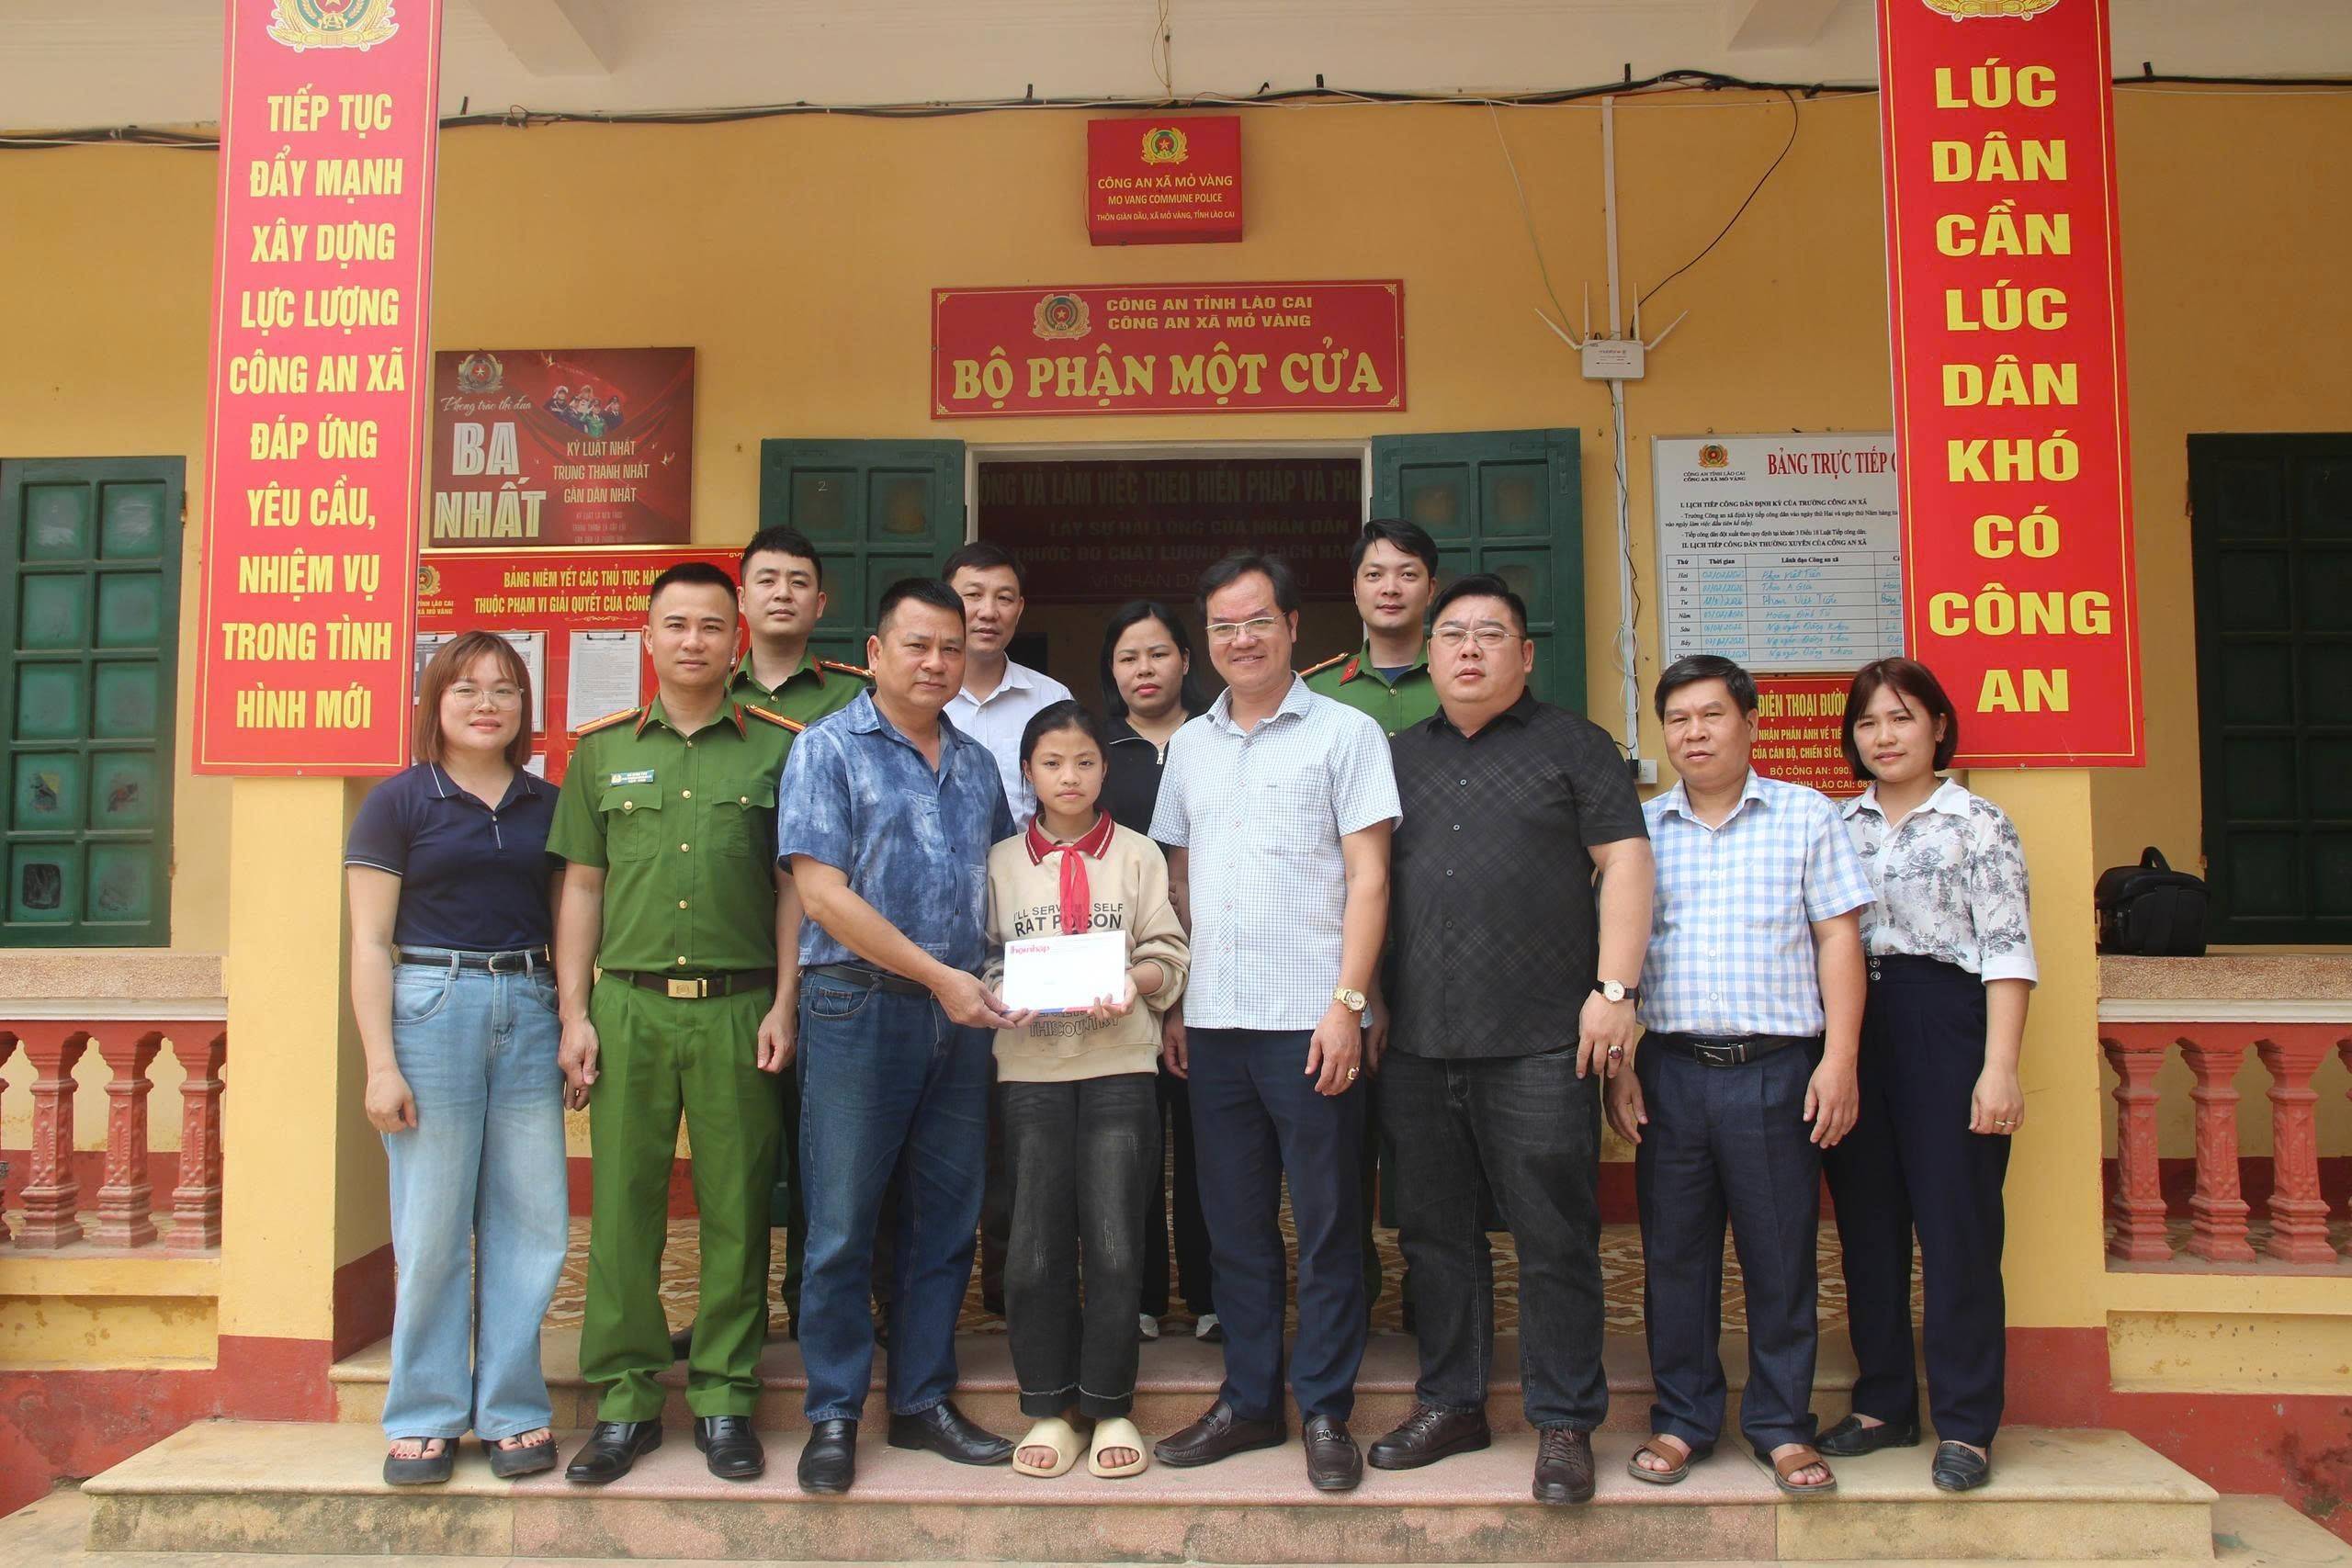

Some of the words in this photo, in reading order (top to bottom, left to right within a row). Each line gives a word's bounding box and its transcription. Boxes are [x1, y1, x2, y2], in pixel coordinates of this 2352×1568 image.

[1935, 57, 2057, 108] LÚC
[267, 84, 330, 132] TIẾP
[338, 94, 393, 139] TỤC
[250, 144, 308, 198] ĐẨY
[315, 158, 402, 204] MẠNH
[1931, 130, 2067, 183] DÂN
[1098, 176, 1132, 189] CÔNG
[1135, 177, 1152, 188] AN
[1155, 175, 1171, 187] XÃ
[1175, 173, 1196, 187] MỎ
[1199, 174, 1233, 186] VÀNG
[1108, 196, 1123, 205] MO
[1125, 195, 1148, 205] VANG
[1148, 194, 1193, 204] COMMUNE
[1194, 193, 1223, 203] POLICE
[1097, 212, 1115, 221] THÔN
[1210, 209, 1223, 219] LÀO
[1935, 198, 2071, 257] CẦN
[250, 218, 309, 263] XÂY
[316, 220, 395, 269] DỰNG
[241, 287, 295, 336] LỰC
[304, 286, 399, 334] LƯỢNG
[1106, 295, 1158, 310] CÔNG
[1161, 297, 1190, 310] AN
[1193, 293, 1237, 310] TỈNH
[1241, 293, 1278, 310] LÀO
[1282, 296, 1313, 309] CAI
[1108, 312, 1159, 330] CÔNG
[1163, 316, 1192, 330] AN
[1195, 313, 1222, 329] XÃ
[1226, 311, 1256, 329] MỎ
[1261, 311, 1312, 328] VÀNG
[1946, 279, 2068, 332] LÚC
[230, 348, 309, 394] CÔNG
[316, 355, 358, 393] AN
[367, 347, 405, 392] XÃ
[952, 344, 1014, 410] BỘ
[1026, 343, 1157, 407] PHẬN
[1169, 341, 1268, 406] MỘT
[1280, 335, 1384, 394] CỬA
[1942, 354, 2078, 406] DÂN
[441, 396, 476, 417] Phong
[499, 396, 513, 412] thi
[250, 414, 310, 460] ĐÁP
[318, 412, 378, 459] ỨNG
[452, 422, 520, 476] BA
[582, 440, 607, 458] LUẬT
[609, 436, 637, 456] NHẤT
[1947, 429, 2080, 482] KHÓ
[553, 465, 585, 480] TRUNG
[588, 462, 620, 479] THÀNH
[623, 460, 650, 479] NHẤT
[1768, 447, 1808, 475] BẢNG
[1811, 449, 1851, 479] TRỰC
[1855, 446, 1887, 473] TIẾP
[246, 480, 301, 527] YÊU
[310, 475, 376, 531] CẦU,
[434, 477, 547, 539] NHẤT
[564, 485, 584, 503] GẦN
[587, 486, 607, 502] DÂN
[610, 483, 637, 502] NHẤT
[1052, 464, 1091, 505] LÀM
[1098, 463, 1139, 510] VIỆC
[1145, 470, 1191, 504] THEO
[1245, 462, 1295, 502] PHÁP
[1302, 463, 1327, 502] VÀ
[1827, 498, 1847, 506] CÔNG
[1973, 505, 2060, 559] CÓ
[238, 547, 334, 602] NHIỆM
[343, 555, 380, 602] VỤ
[503, 566, 530, 588] BẢNG
[532, 568, 558, 587] NIÊM
[560, 565, 577, 587] YẾT
[579, 566, 599, 587] CÁC
[601, 564, 619, 587] THỦ
[622, 570, 640, 590] TỤC
[475, 594, 505, 617] THUỘC
[507, 596, 536, 616] PHẠM
[537, 596, 547, 613] VI
[549, 590, 568, 613] GIẢI
[571, 591, 602, 614] QUYẾT
[604, 589, 623, 612] CỦA
[1929, 582, 2111, 636] CÔNG
[221, 622, 316, 661] TRONG
[326, 615, 392, 660] TÌNH
[236, 682, 306, 728] HÌNH
[315, 682, 371, 728] MỚI
[1758, 690, 1783, 722] ĐIỆN
[1785, 694, 1816, 722] THOẠI
[1976, 669, 2069, 713] AN
[1752, 744, 1767, 760] CỦA
[1769, 746, 1784, 759] CÁN
[1786, 745, 1799, 762] BỘ,
[1800, 744, 1823, 759] CHIẾN
[1758, 728, 1780, 742] NHẬN
[1781, 725, 1802, 740] PHẢN
[1803, 726, 1819, 740] ÁNH
[1770, 765, 1784, 776] BỘ
[1785, 765, 1813, 775] CÔNG
[1815, 767, 1831, 775] AN:
[1815, 778, 1835, 788] LÀO
[1837, 780, 1855, 788] CAI:
[1014, 917, 1047, 937] RAT
[1093, 903, 1124, 912] SELF
